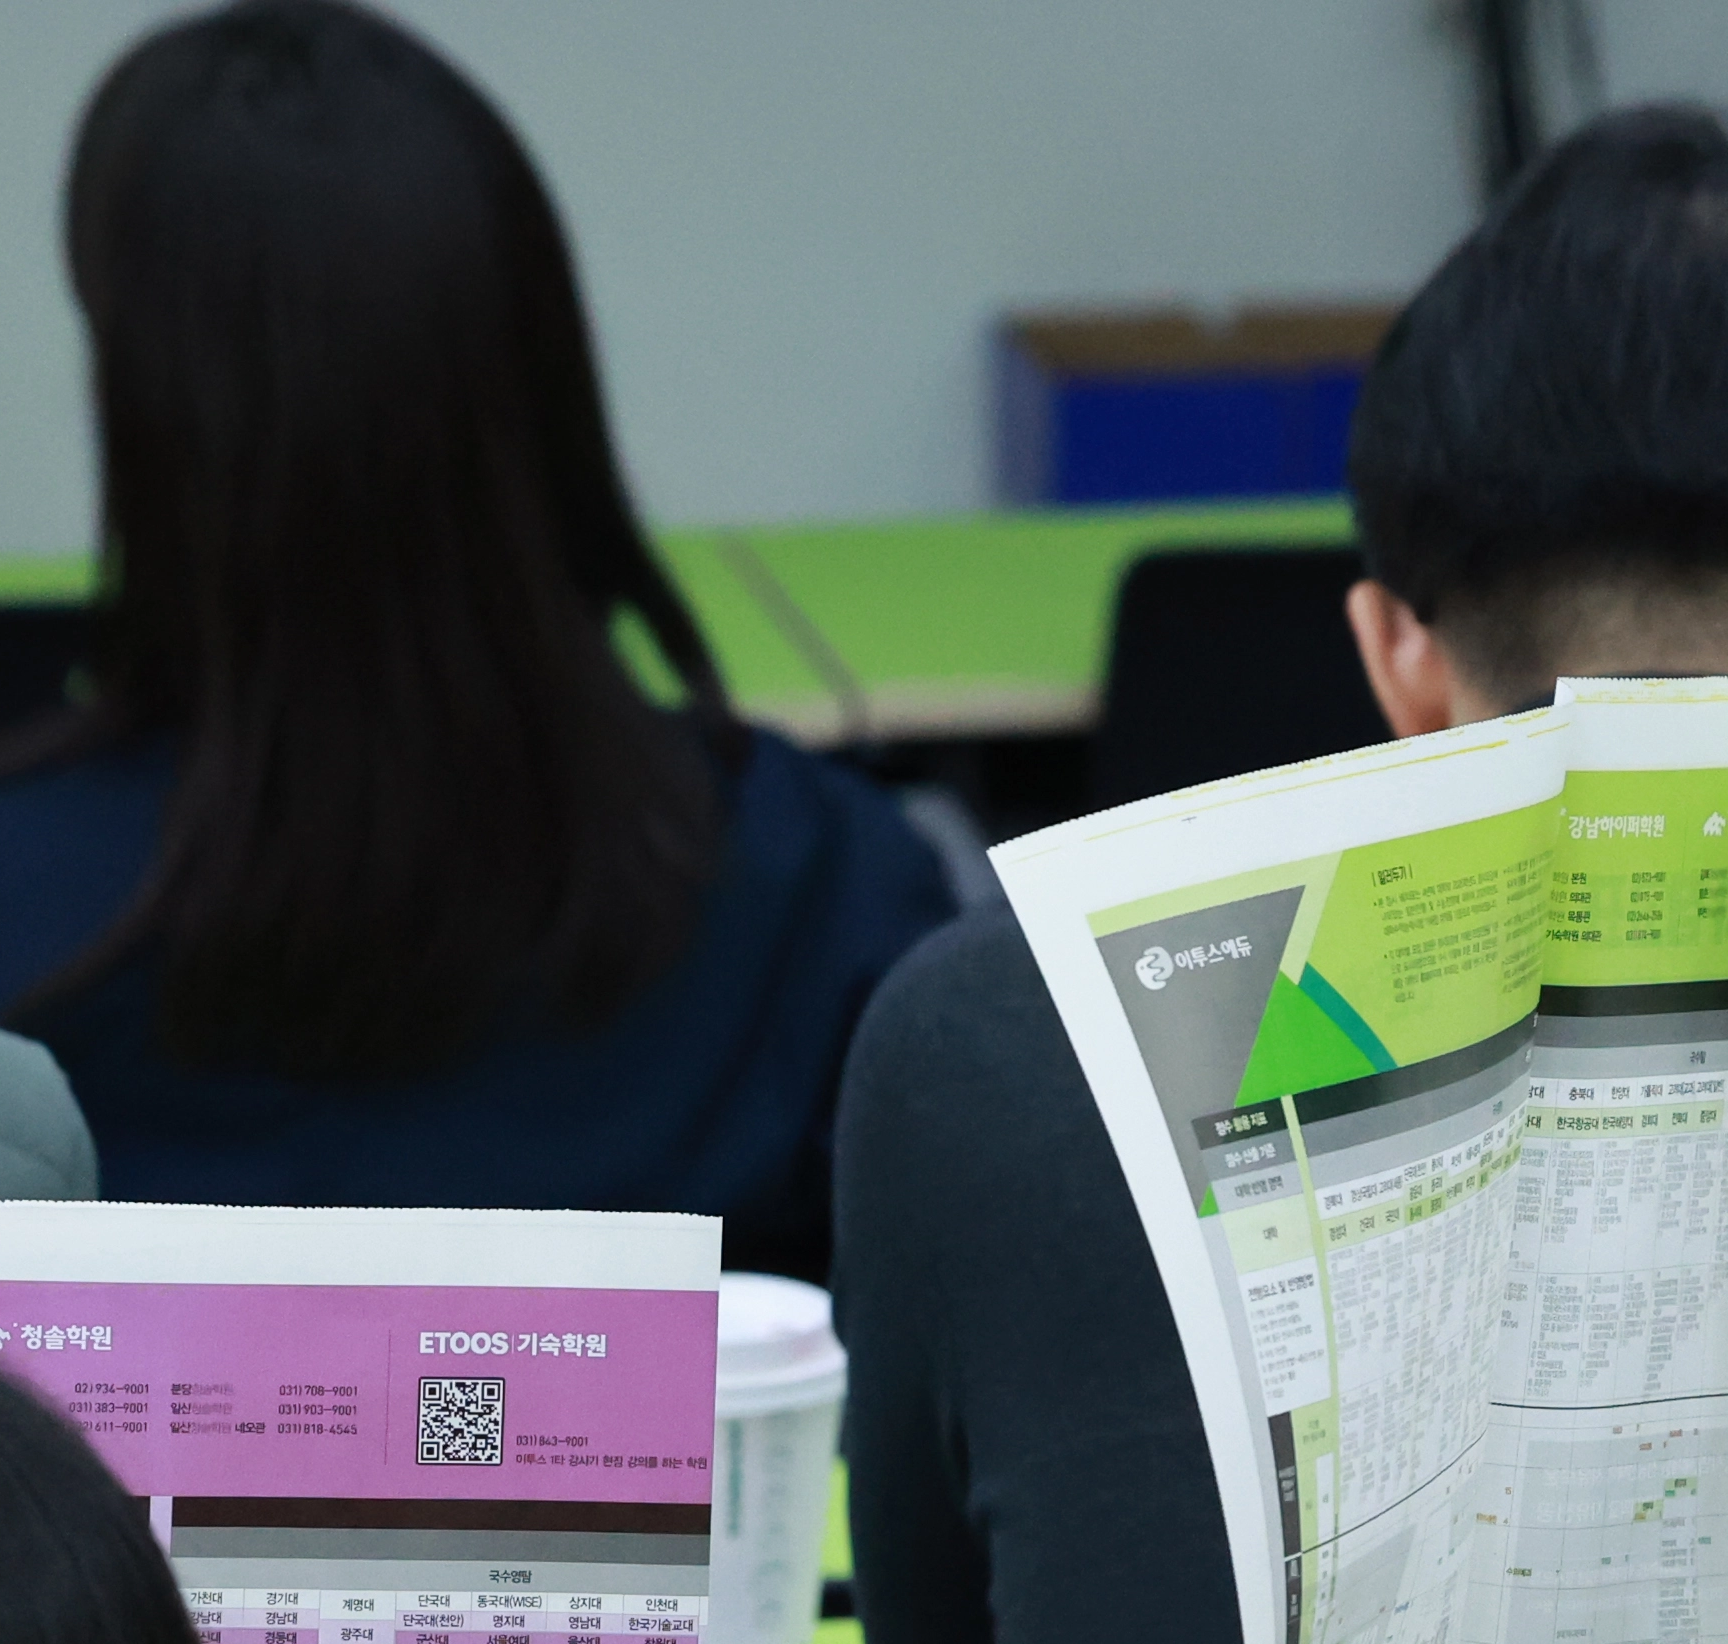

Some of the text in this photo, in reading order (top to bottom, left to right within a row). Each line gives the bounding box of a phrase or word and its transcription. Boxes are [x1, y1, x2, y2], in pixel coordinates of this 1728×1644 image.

[1568, 815, 1665, 839] 강남하이퍼학원
[1174, 935, 1253, 971] 이투스에듀
[1556, 1116, 1599, 1130] 한국항공대
[20, 1324, 113, 1351] 청솔학원
[419, 1331, 608, 1358] ETOOS 기숙학원
[76, 1420, 148, 1433] 2)611-9001
[234, 1421, 266, 1435] 네오관
[190, 1591, 678, 1612] 가천대 경기대 단국대 동국대(WISE) 상지대 인천대
[342, 1599, 375, 1612] 계명대
[265, 1612, 298, 1625] 경남대
[403, 1614, 465, 1628] 단국대(천안)
[492, 1615, 525, 1628] 명지대
[568, 1616, 601, 1630] 영남대
[628, 1618, 694, 1632] 한국기술교대
[340, 1627, 374, 1641] 광주대
